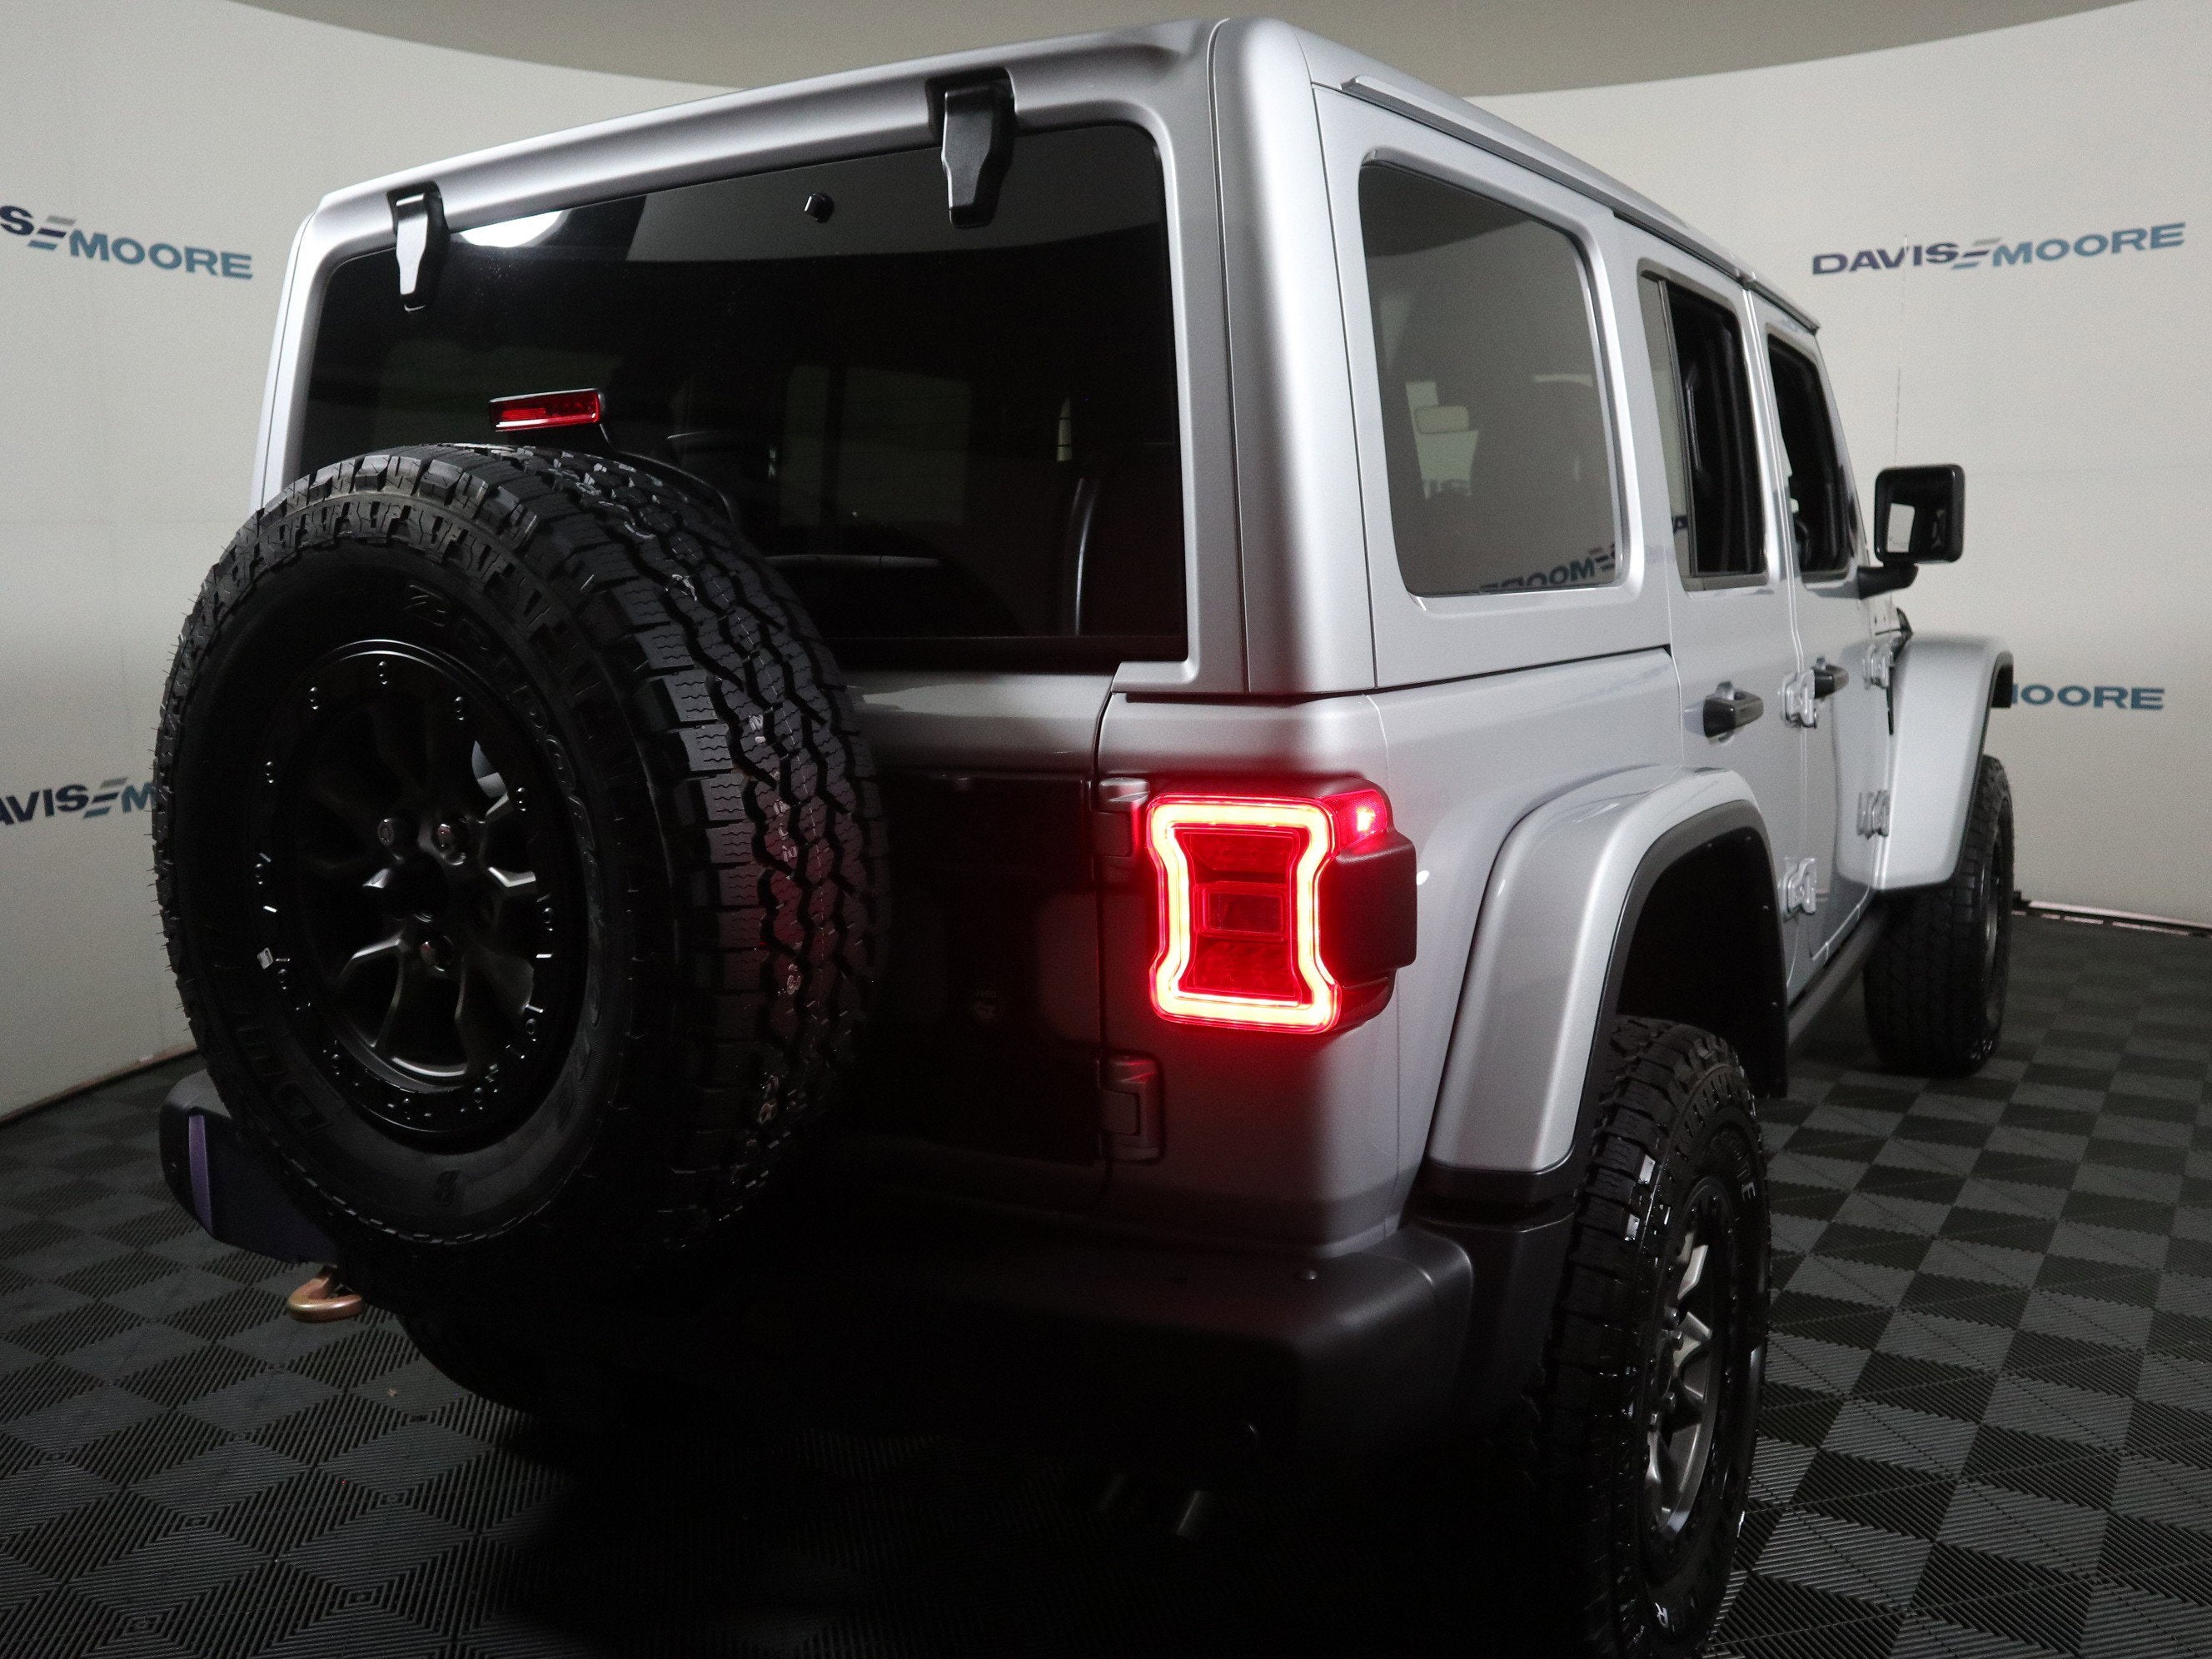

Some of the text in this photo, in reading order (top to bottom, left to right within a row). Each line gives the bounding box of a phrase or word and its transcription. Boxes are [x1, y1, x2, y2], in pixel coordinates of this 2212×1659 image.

[70, 229, 252, 279] MOORE
[1812, 222, 2186, 275] DAVIS MOORE
[2013, 683, 2165, 710] OORE
